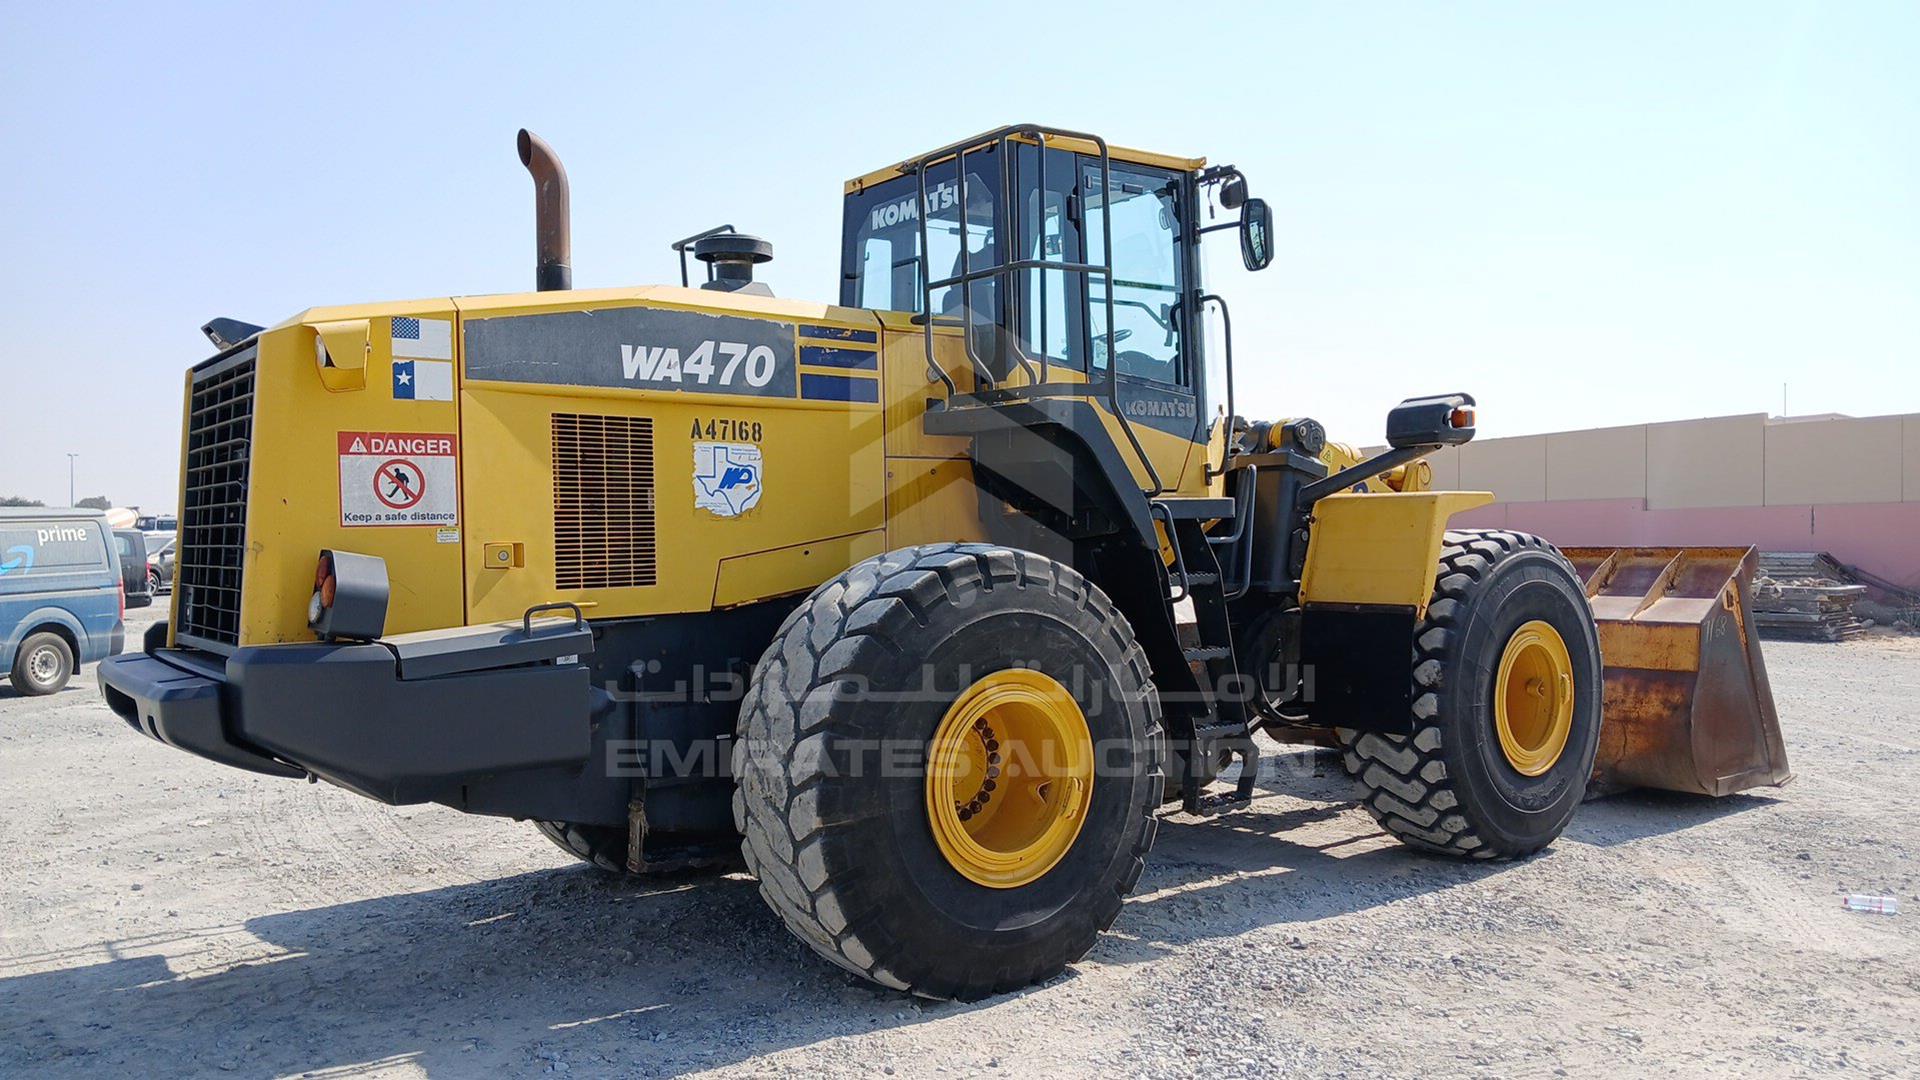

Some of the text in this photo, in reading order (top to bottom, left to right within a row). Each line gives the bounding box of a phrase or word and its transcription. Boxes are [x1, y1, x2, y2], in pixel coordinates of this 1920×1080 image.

[620, 340, 776, 388] WA470
[1124, 398, 1196, 418] KOMATSU
[690, 417, 763, 443] A47168
[371, 438, 452, 454] DANGER
[344, 511, 455, 523] Keep a safe distance
[37, 524, 87, 546] prime
